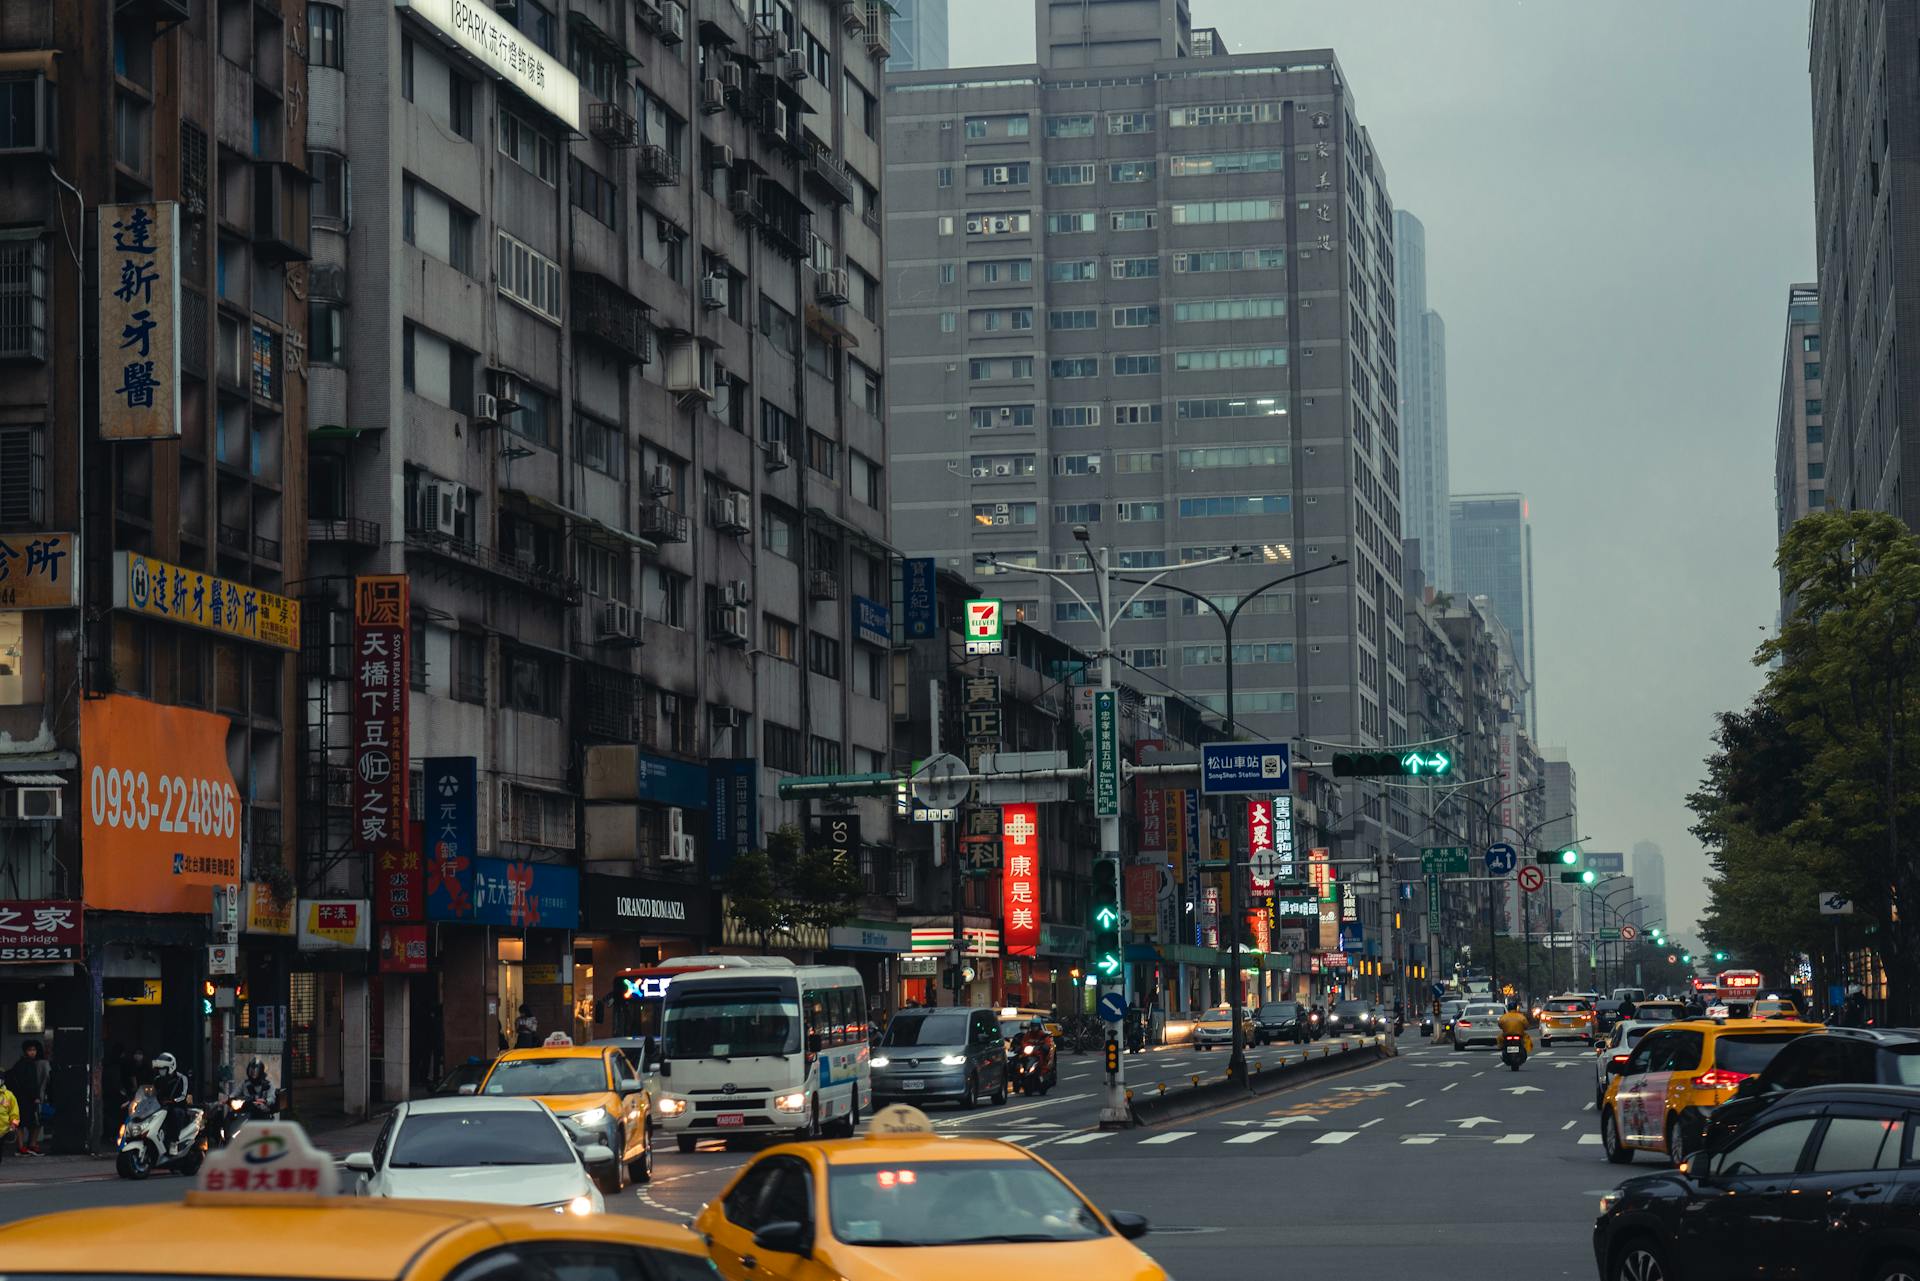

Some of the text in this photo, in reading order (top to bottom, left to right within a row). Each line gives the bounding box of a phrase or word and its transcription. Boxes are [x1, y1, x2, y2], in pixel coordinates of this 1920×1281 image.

[113, 208, 161, 408] 達新牙醫
[153, 565, 258, 636] 達新牙醫診所
[392, 633, 401, 712] SOYA BEAN MILK
[1101, 711, 1112, 771] 忠孝東路五段
[1207, 755, 1259, 769] 松山車站
[1208, 771, 1237, 780] SongShan
[91, 765, 235, 839] 0933-224896
[440, 803, 458, 878] 元大銀行
[1424, 847, 1465, 858] 虎林街
[488, 878, 527, 907] 元大銀行
[617, 896, 685, 920] LORANZO ROMANZA
[1010, 855, 1033, 930] 康是美
[20, 935, 59, 944] Bridge
[206, 1168, 320, 1191] 台灣大車隊
